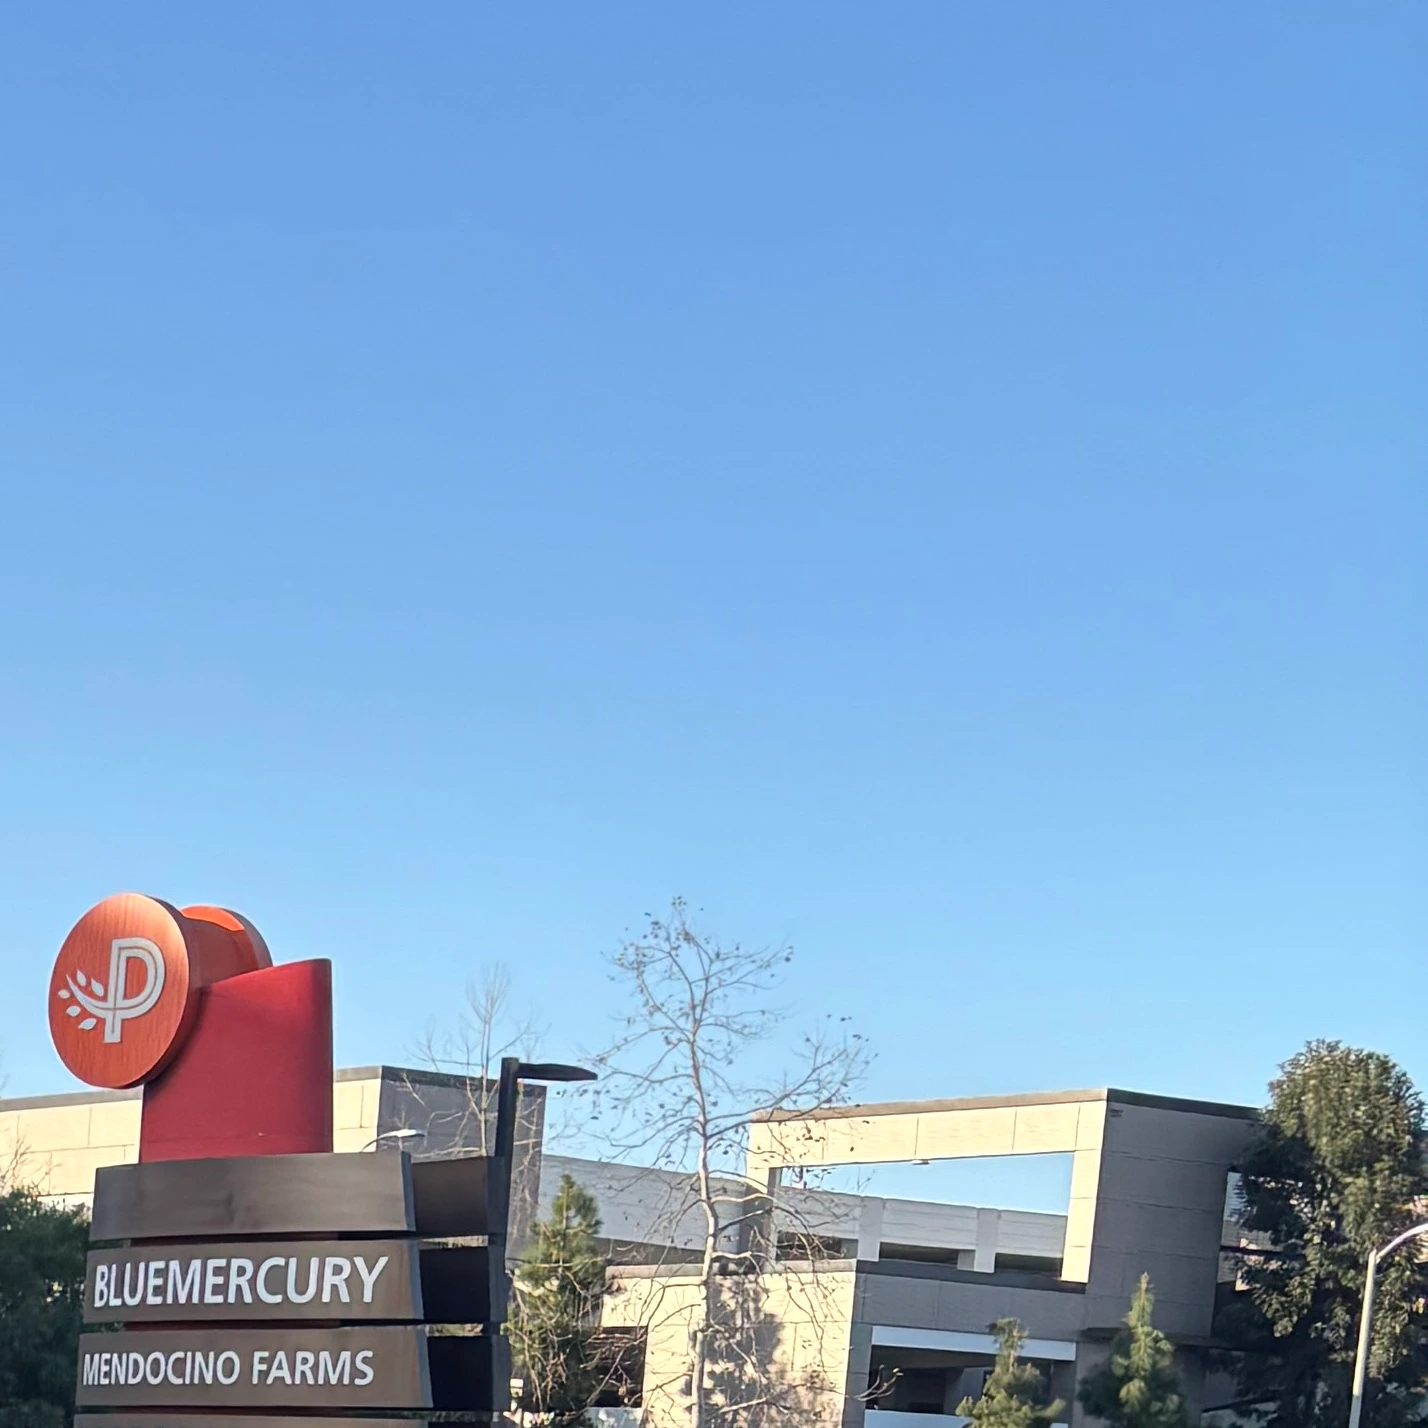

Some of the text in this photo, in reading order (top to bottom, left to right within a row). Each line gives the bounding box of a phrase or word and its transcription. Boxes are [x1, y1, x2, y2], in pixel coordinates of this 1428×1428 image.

[93, 1256, 389, 1308] BLUEMERCURY
[82, 1350, 375, 1387] MENDOCINO FARMS
